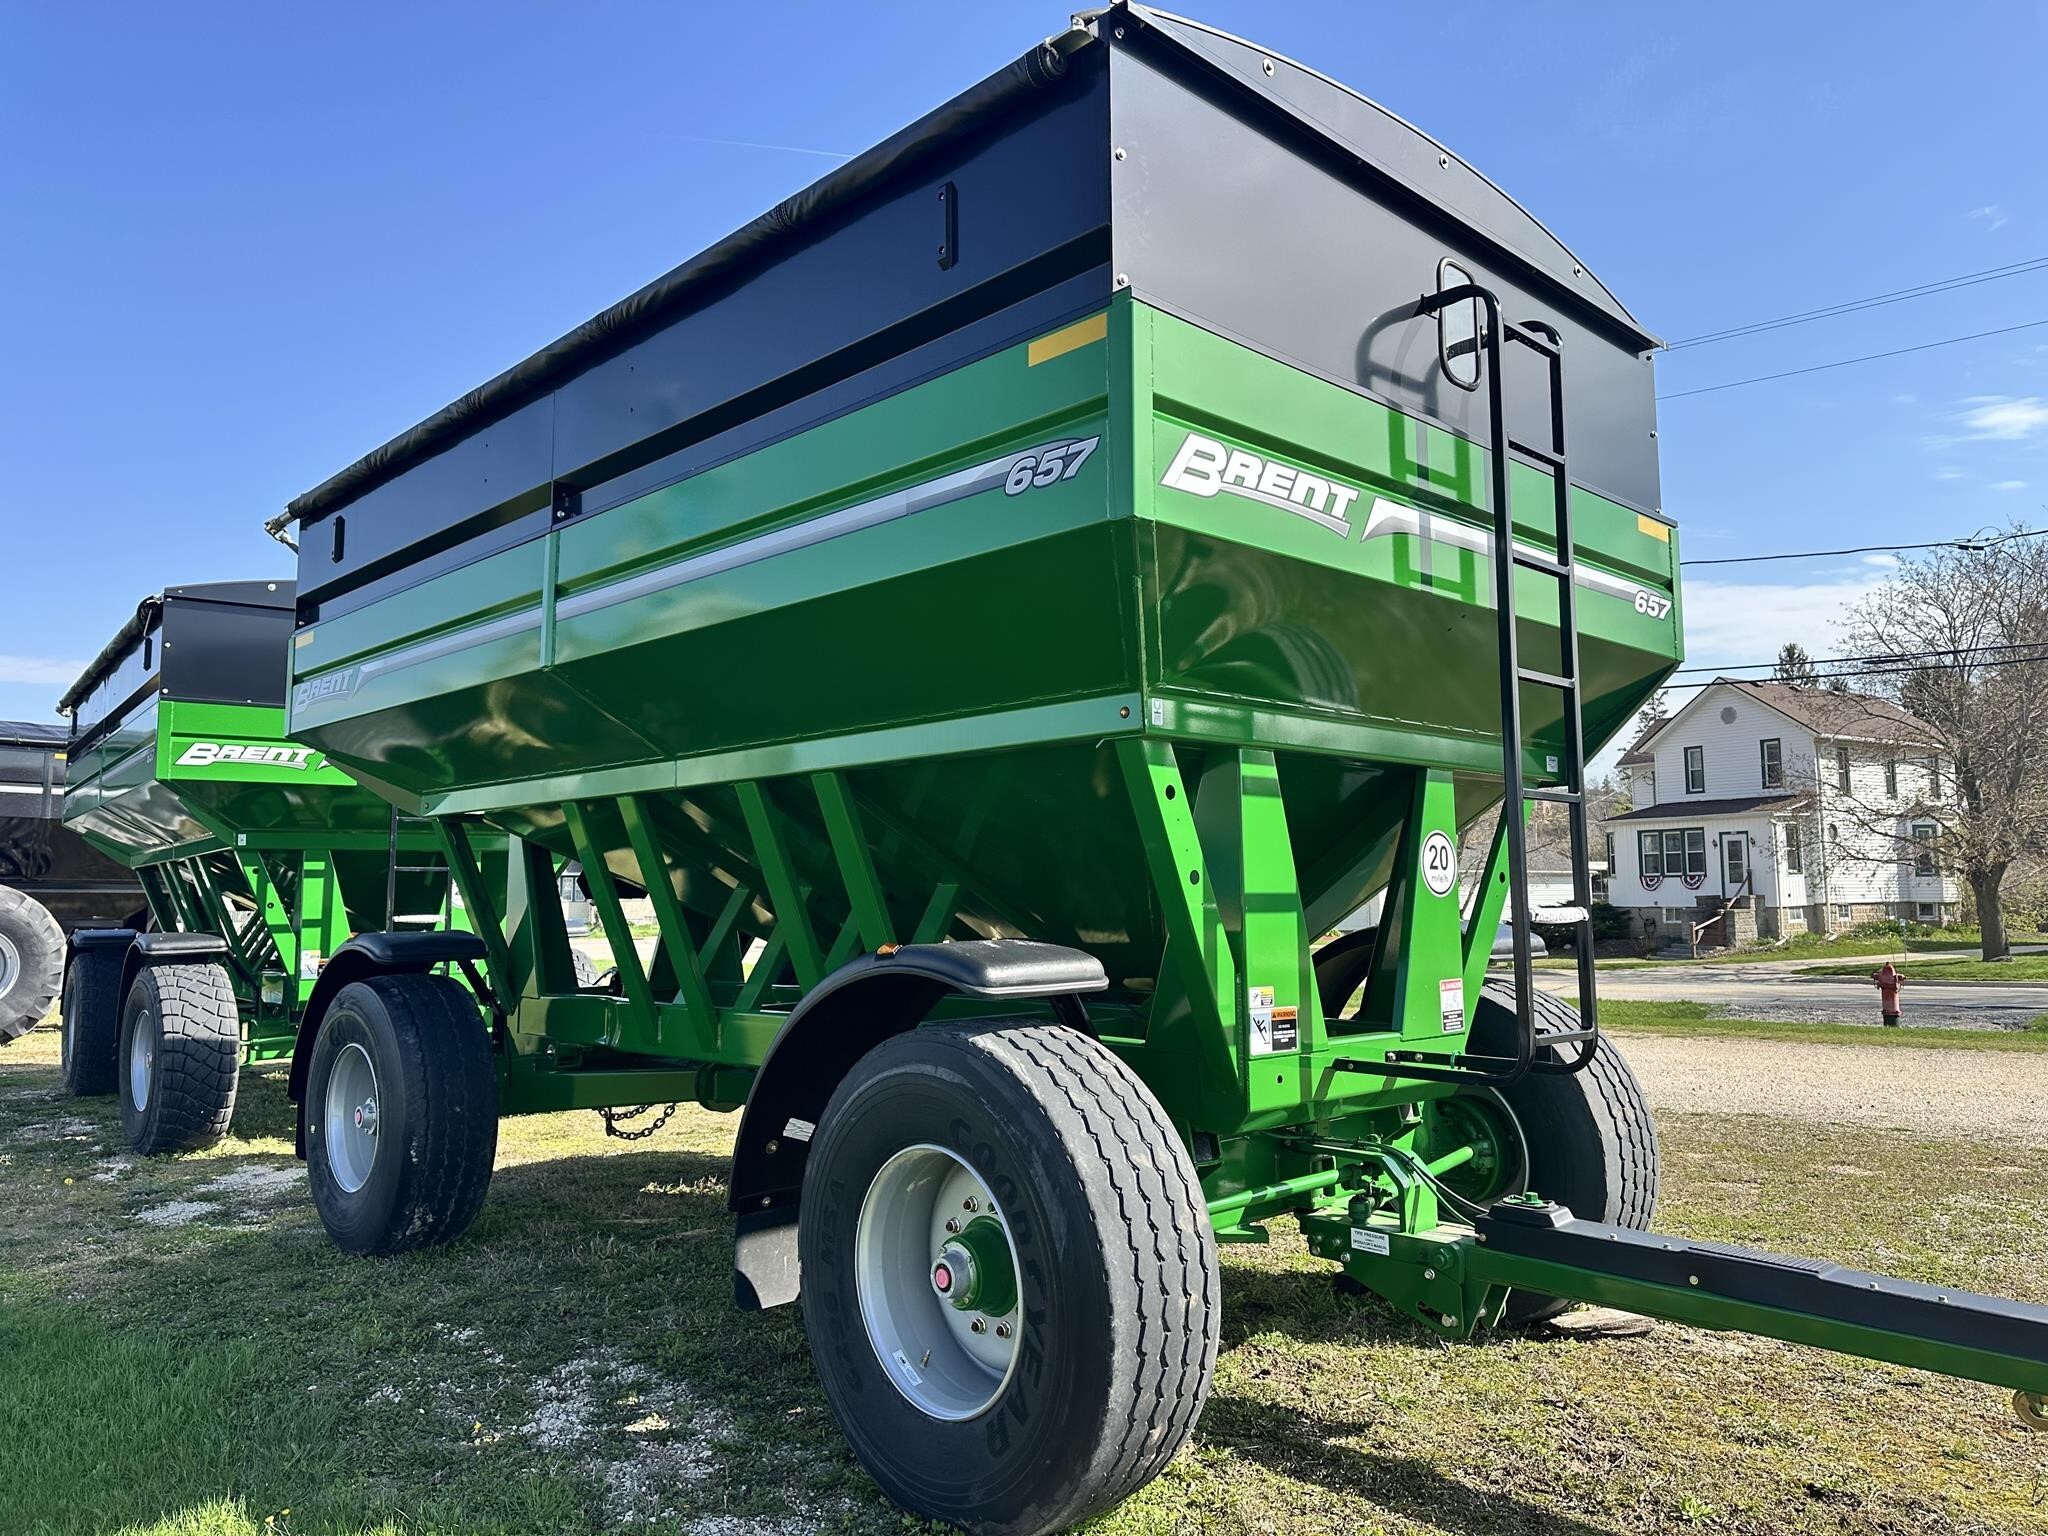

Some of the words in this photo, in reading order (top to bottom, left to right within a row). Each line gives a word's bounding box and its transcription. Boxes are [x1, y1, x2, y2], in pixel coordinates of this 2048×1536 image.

[1005, 435, 1100, 495] 657
[1158, 432, 1360, 523] BRENT
[1635, 590, 1672, 620] 657
[293, 669, 354, 714] BRENT
[174, 742, 316, 768] BRENT
[1429, 845, 1448, 870] 20
